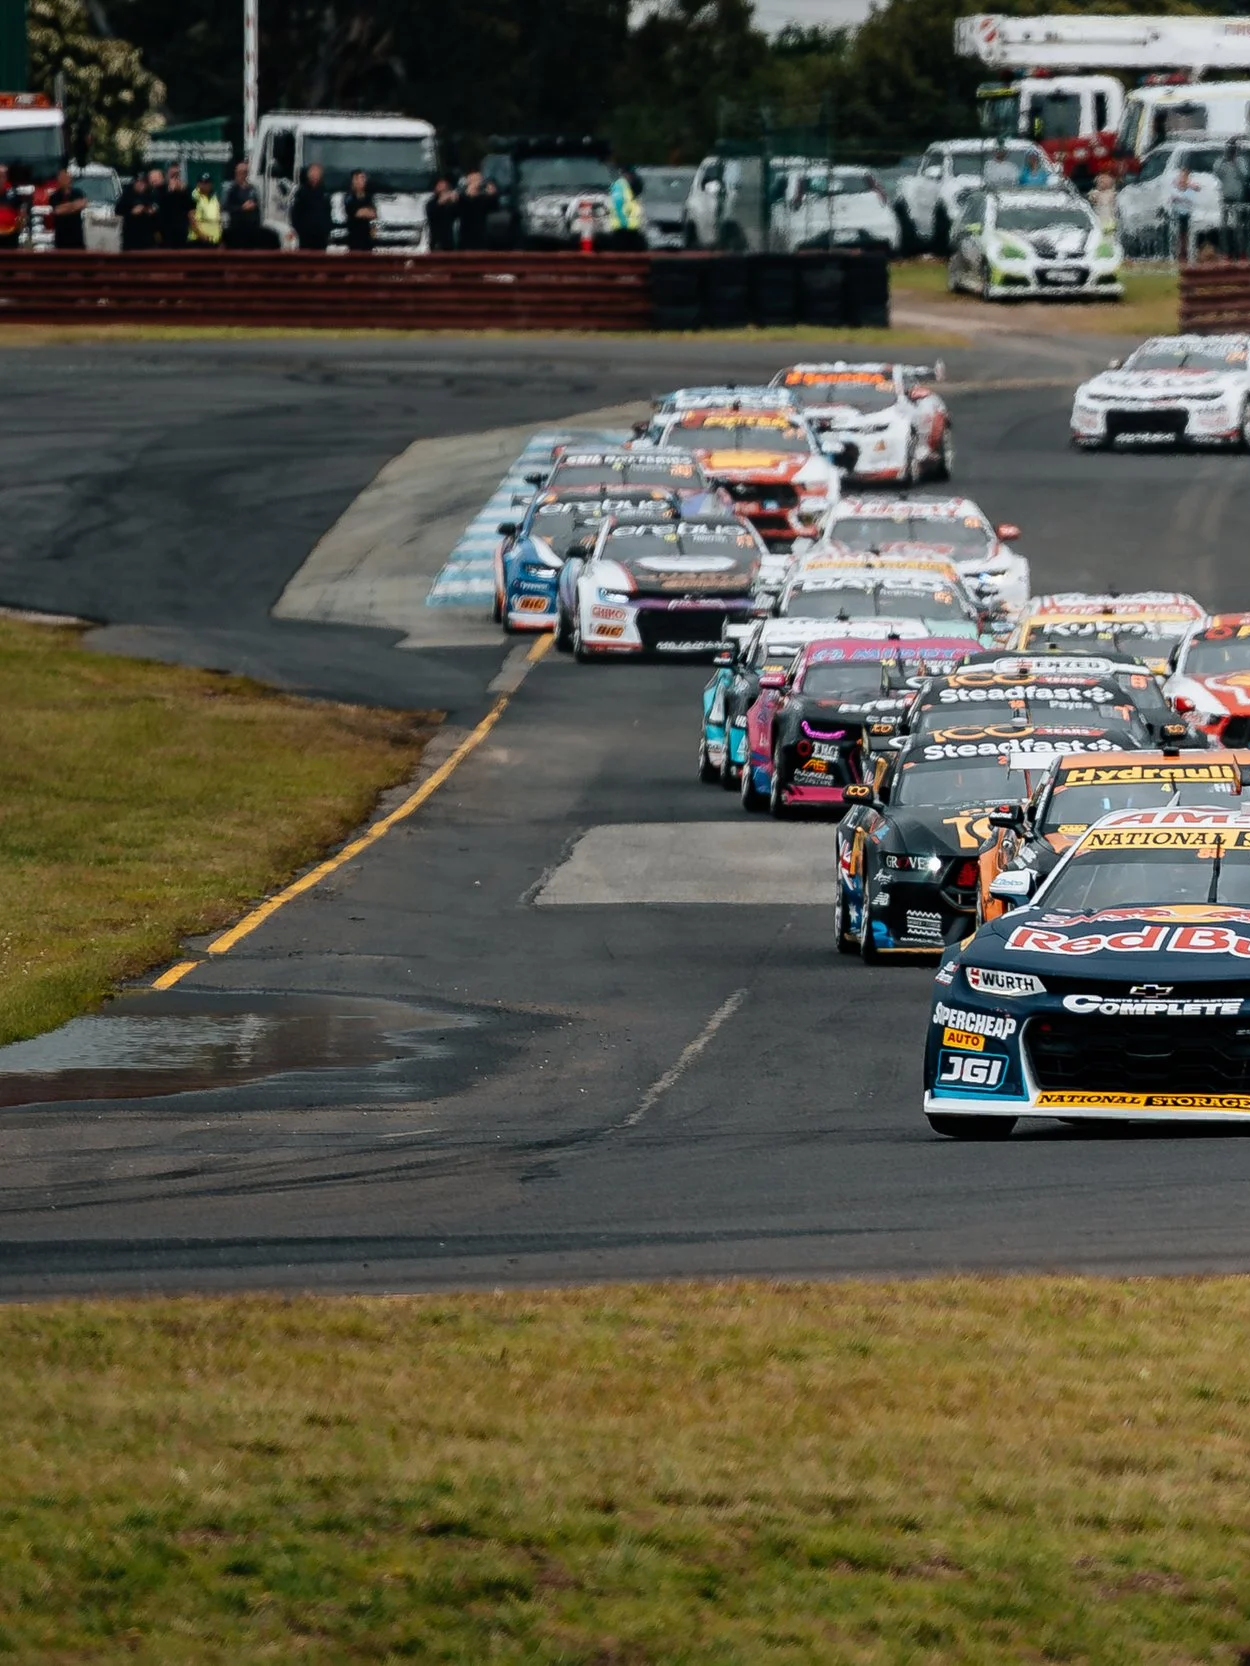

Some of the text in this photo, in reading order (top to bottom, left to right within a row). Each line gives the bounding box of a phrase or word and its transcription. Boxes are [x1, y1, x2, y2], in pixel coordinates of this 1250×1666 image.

[939, 686, 1082, 704] Steadfast
[924, 738, 1082, 761] Steadfast
[1066, 765, 1235, 781] Hydrauli
[1089, 831, 1228, 847] NATIONAL
[1005, 922, 1168, 956] Red
[982, 971, 1034, 991] WÜRTH
[1063, 994, 1242, 1015] COMPLETE
[932, 1001, 1017, 1040] SUPERCHEAP
[947, 1032, 980, 1047] AUTO
[940, 1056, 1002, 1085] JGI
[1039, 1094, 1140, 1105] NATIONAL
